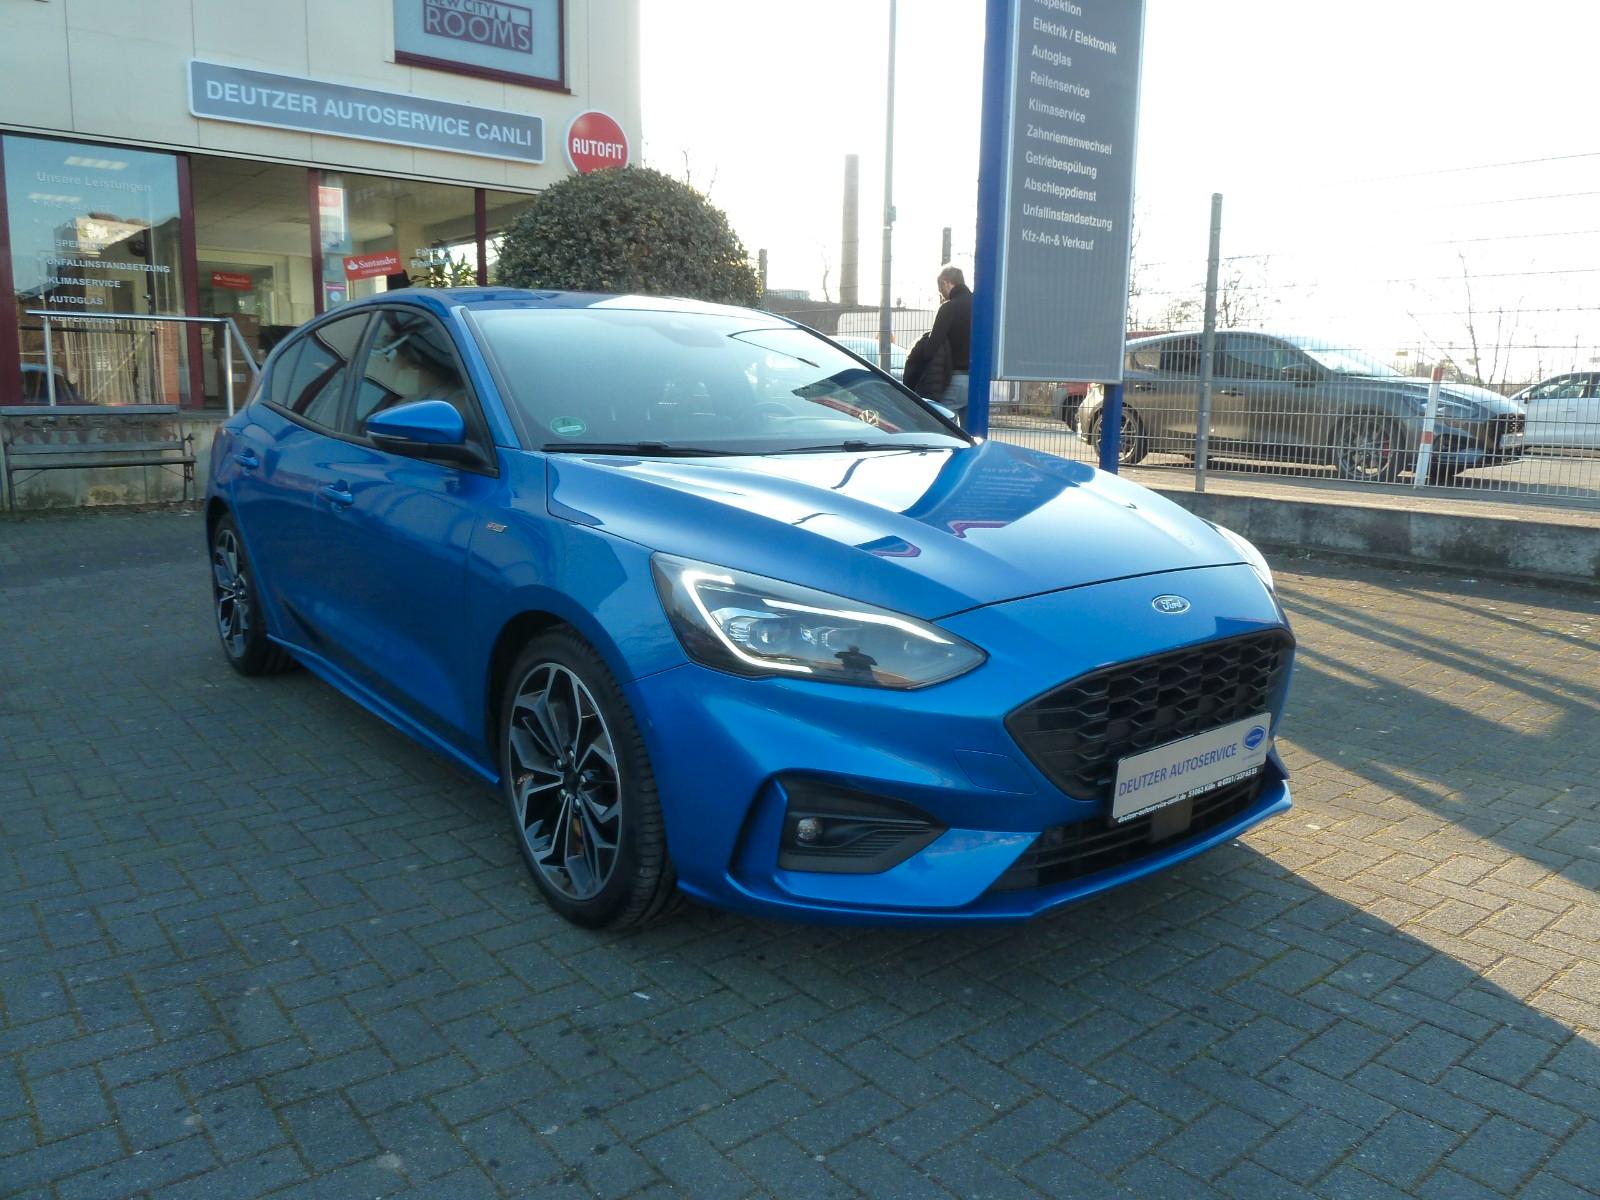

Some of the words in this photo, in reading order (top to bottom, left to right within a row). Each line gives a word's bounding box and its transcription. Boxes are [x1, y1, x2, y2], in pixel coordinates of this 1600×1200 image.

[464, 0, 491, 17] CITY
[425, 6, 530, 50] ROOMS
[1033, 17, 1068, 40] Elektrik
[1074, 30, 1117, 54] Elektronik
[1032, 44, 1072, 67] Autoglas
[1030, 71, 1090, 98] Reifenservice
[206, 79, 318, 115] DEUTZER
[323, 98, 470, 137] AUTOSERVICE
[475, 122, 532, 147] CANLI
[1028, 97, 1086, 123] Klimaservice
[572, 137, 624, 160] AUTOFIT
[1026, 124, 1113, 155] Zahnriemenwechsel
[1025, 151, 1097, 179] Getriebespülung
[1024, 177, 1097, 202] Abschleppdienst
[1023, 203, 1113, 232] Unfallinstandsetzung
[1062, 235, 1094, 251] Verkauf
[359, 256, 397, 270] Santander
[48, 276, 121, 288] KLIMASERVICE
[49, 295, 104, 305] AUTOGLAS
[1118, 766, 1168, 797] DEUTZER
[1168, 742, 1238, 778] AUTOSERVICE
